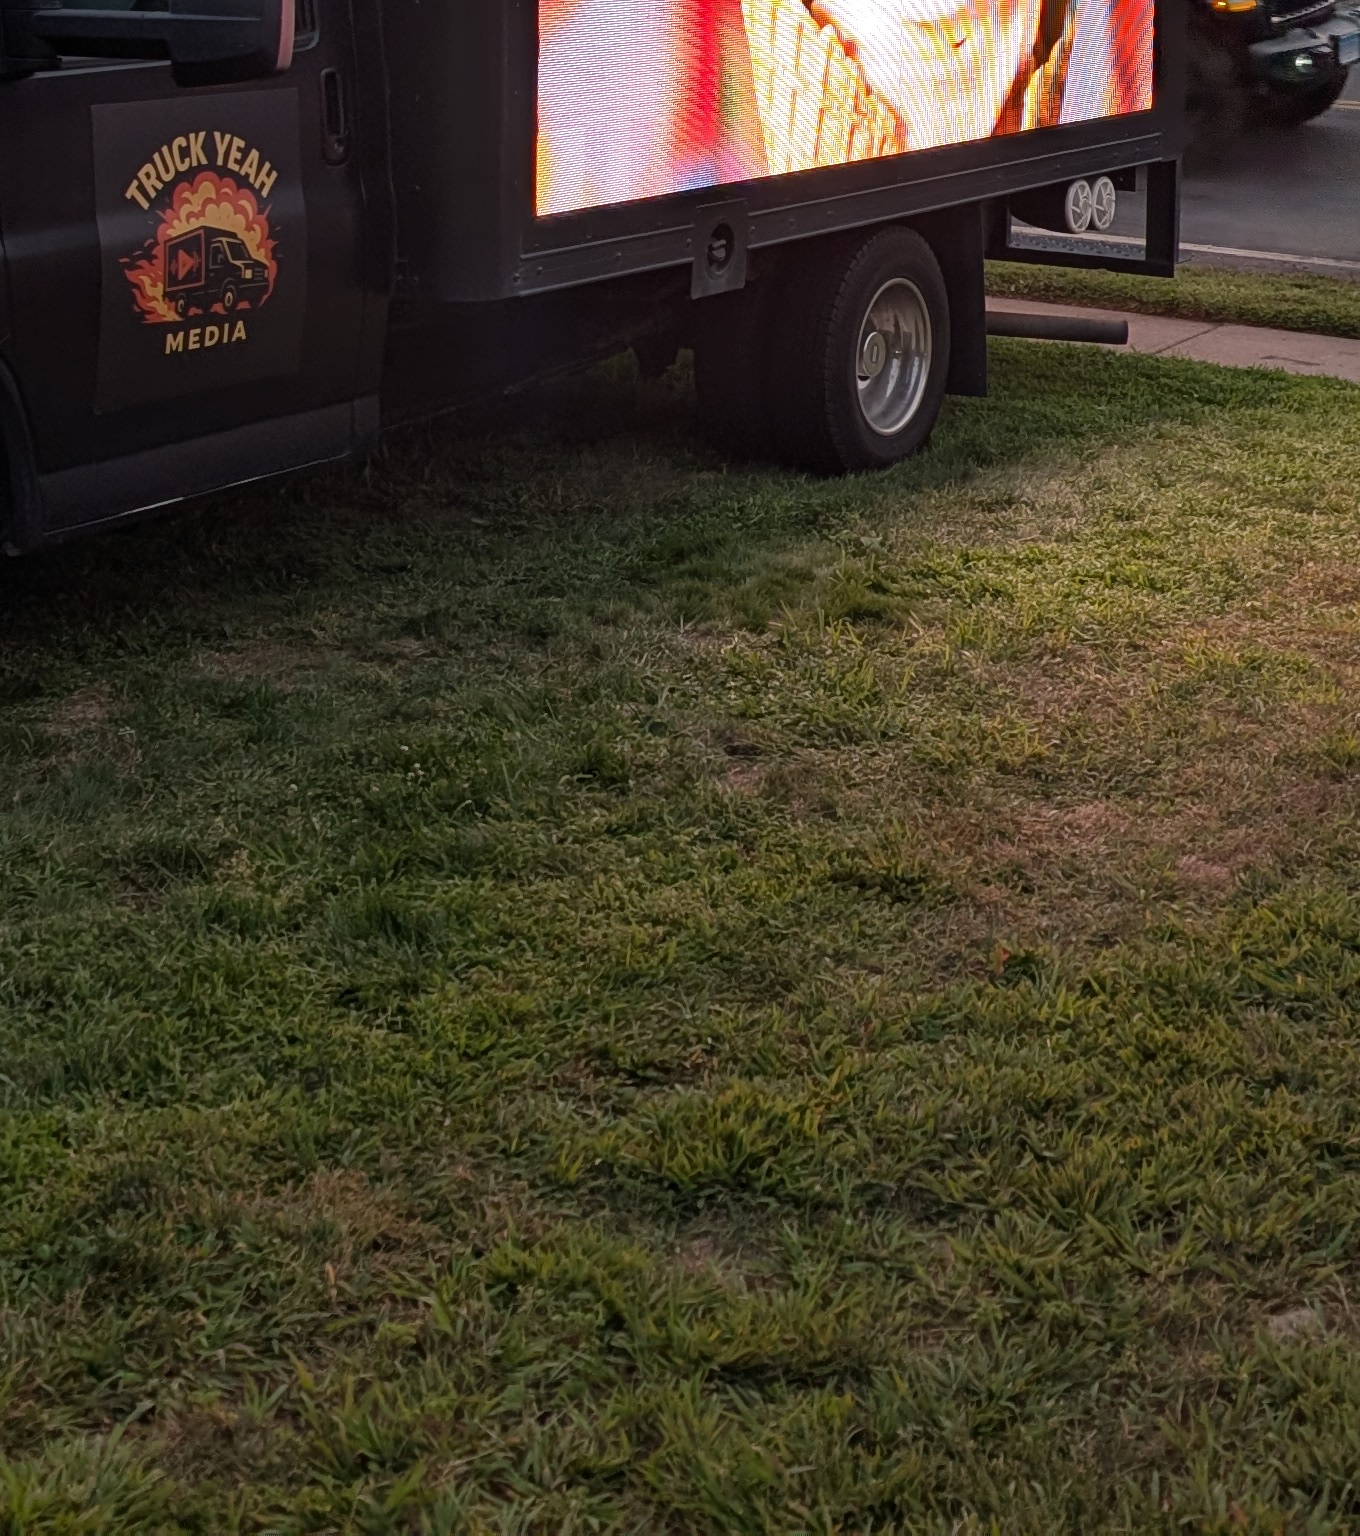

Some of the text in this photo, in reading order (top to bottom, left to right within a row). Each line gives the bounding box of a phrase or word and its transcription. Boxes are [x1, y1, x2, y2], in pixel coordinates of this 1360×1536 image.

[125, 131, 278, 210] TRUCK YEAH
[165, 320, 246, 354] MEDIA
